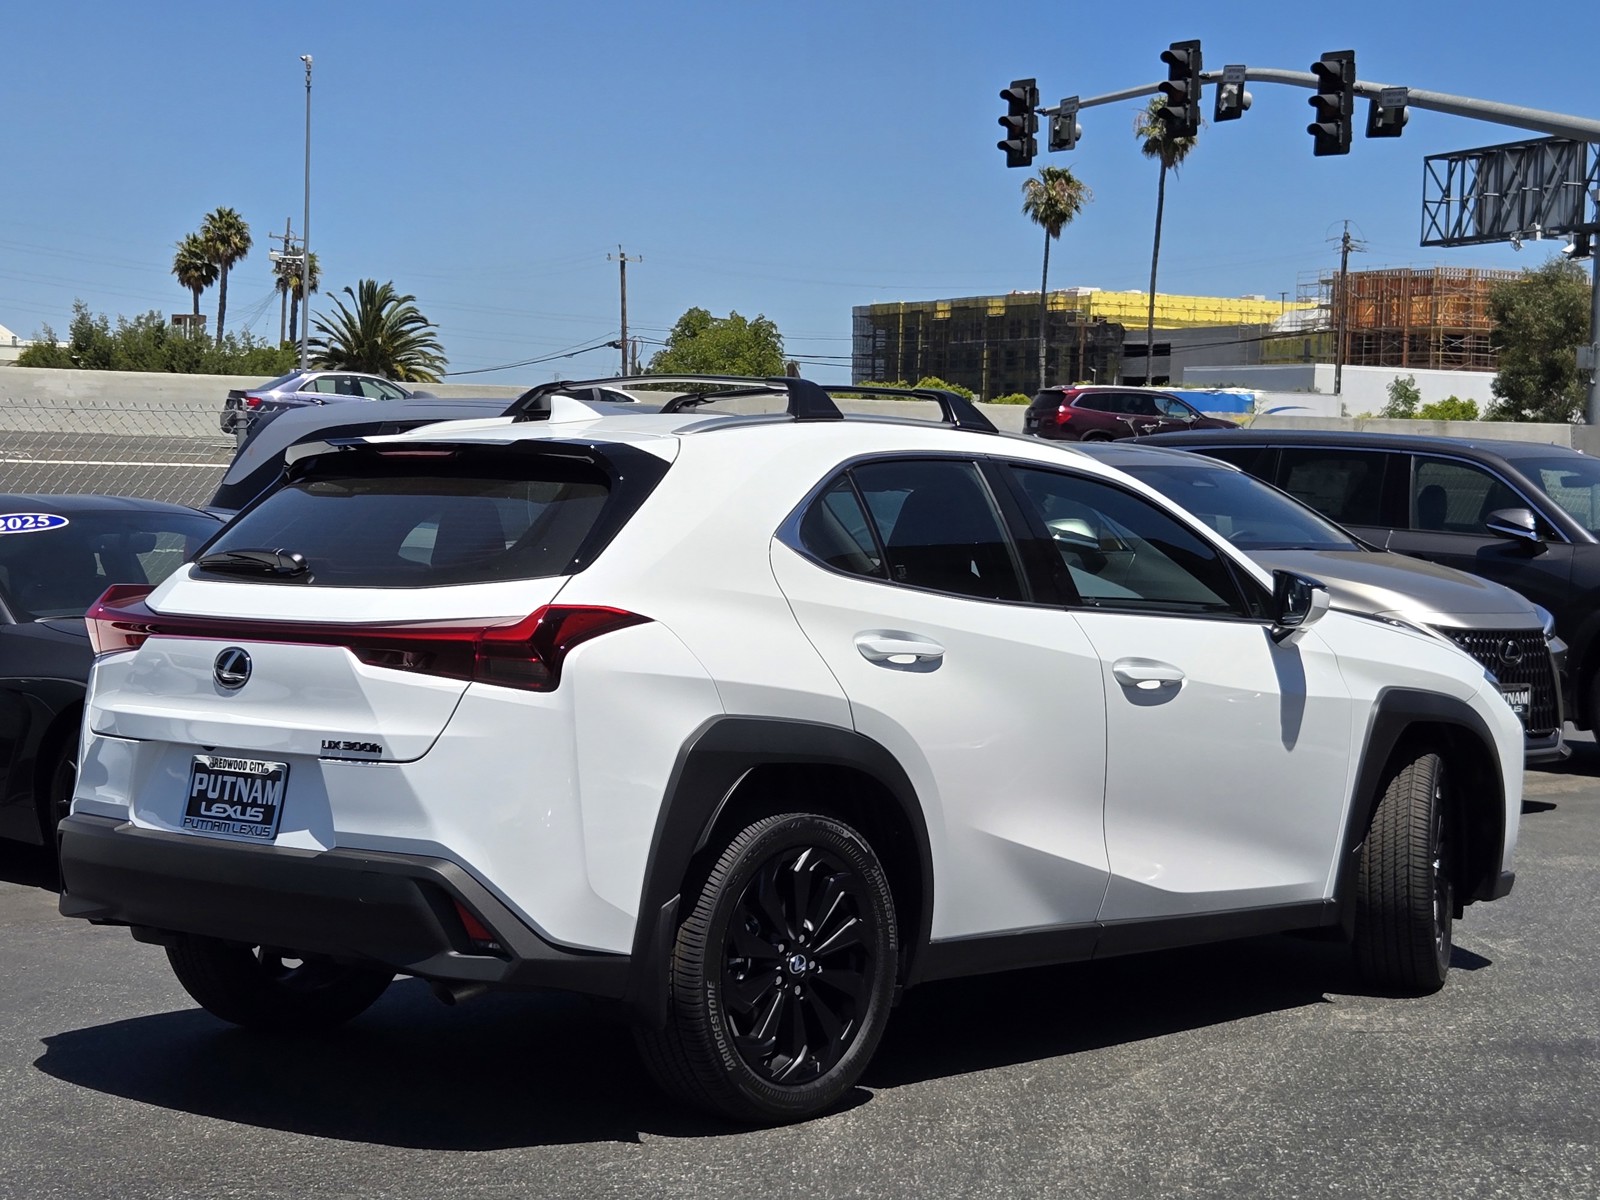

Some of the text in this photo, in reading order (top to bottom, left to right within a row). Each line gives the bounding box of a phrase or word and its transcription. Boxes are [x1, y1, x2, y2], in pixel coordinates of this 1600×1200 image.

[1502, 692, 1528, 705] TNAM
[321, 739, 383, 754] UX 300h
[213, 758, 266, 774] REDWOOD CITY
[191, 772, 281, 806] PUTNAM
[200, 801, 265, 822] LEXUS
[183, 817, 272, 837] PUTNAM LEXUS
[870, 865, 896, 951] BRIDGESTONE
[706, 979, 737, 1072] BRIDGESTONE
